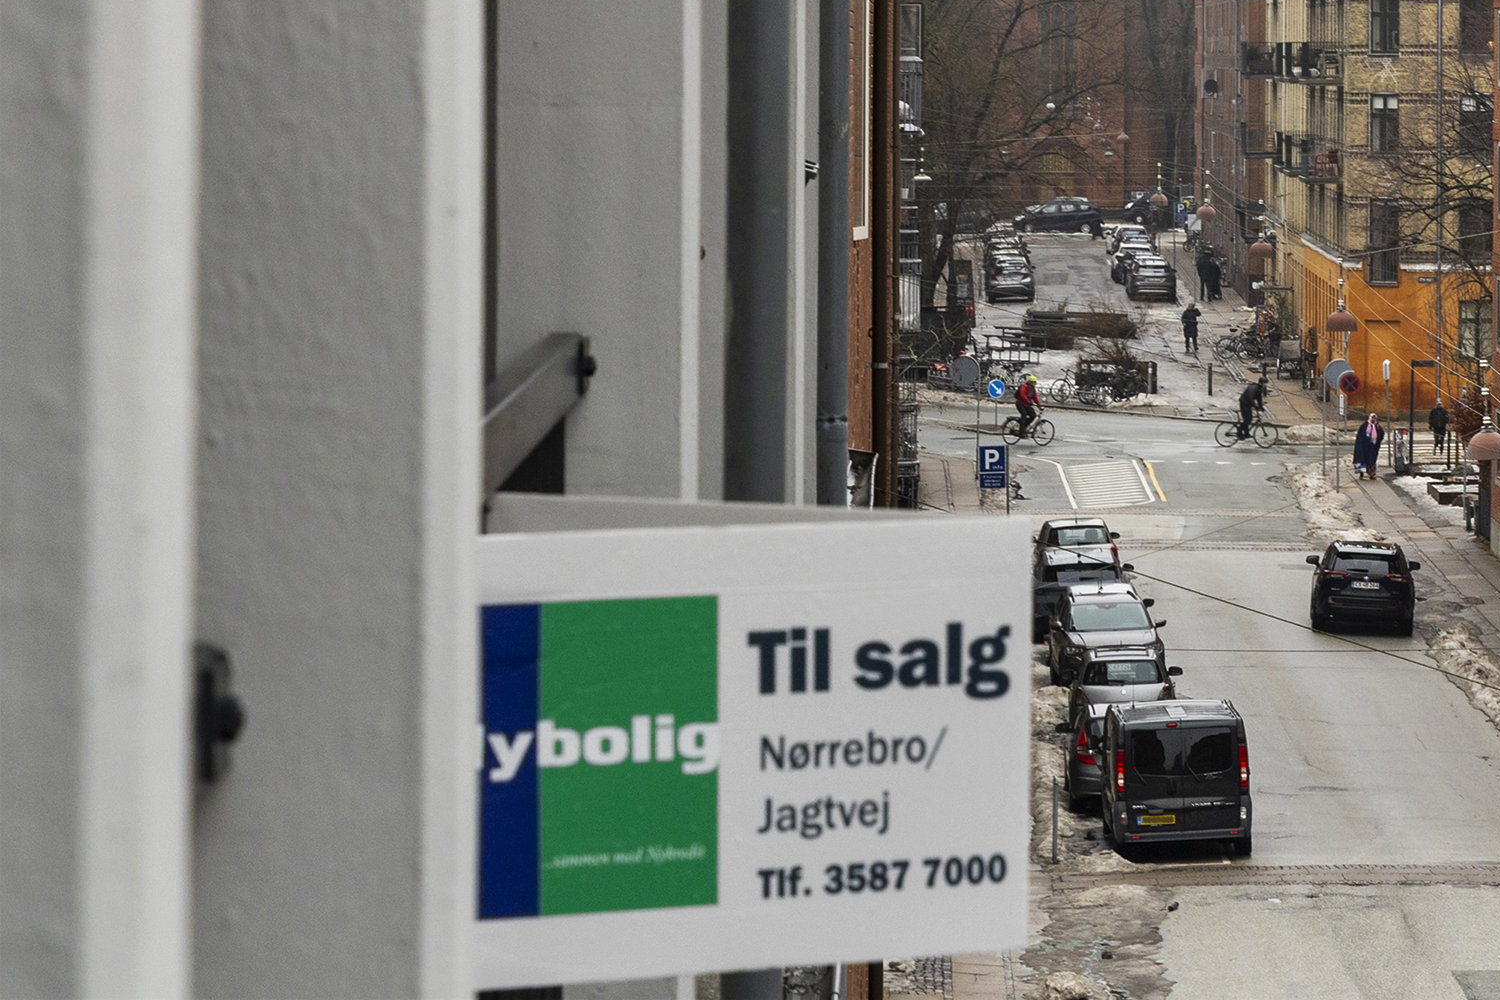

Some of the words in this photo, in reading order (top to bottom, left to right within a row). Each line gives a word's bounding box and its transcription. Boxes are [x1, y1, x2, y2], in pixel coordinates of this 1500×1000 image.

[1177, 203, 1185, 213] P
[984, 449, 1000, 470] P
[746, 626, 831, 696] Til
[853, 621, 1012, 701] salg
[478, 713, 720, 783] ybolig
[758, 725, 949, 774] Nørrebro/
[757, 791, 890, 841] Jagtvej
[757, 865, 812, 900] Tlf.
[823, 859, 910, 896] 3587
[922, 853, 1008, 889] 7000
